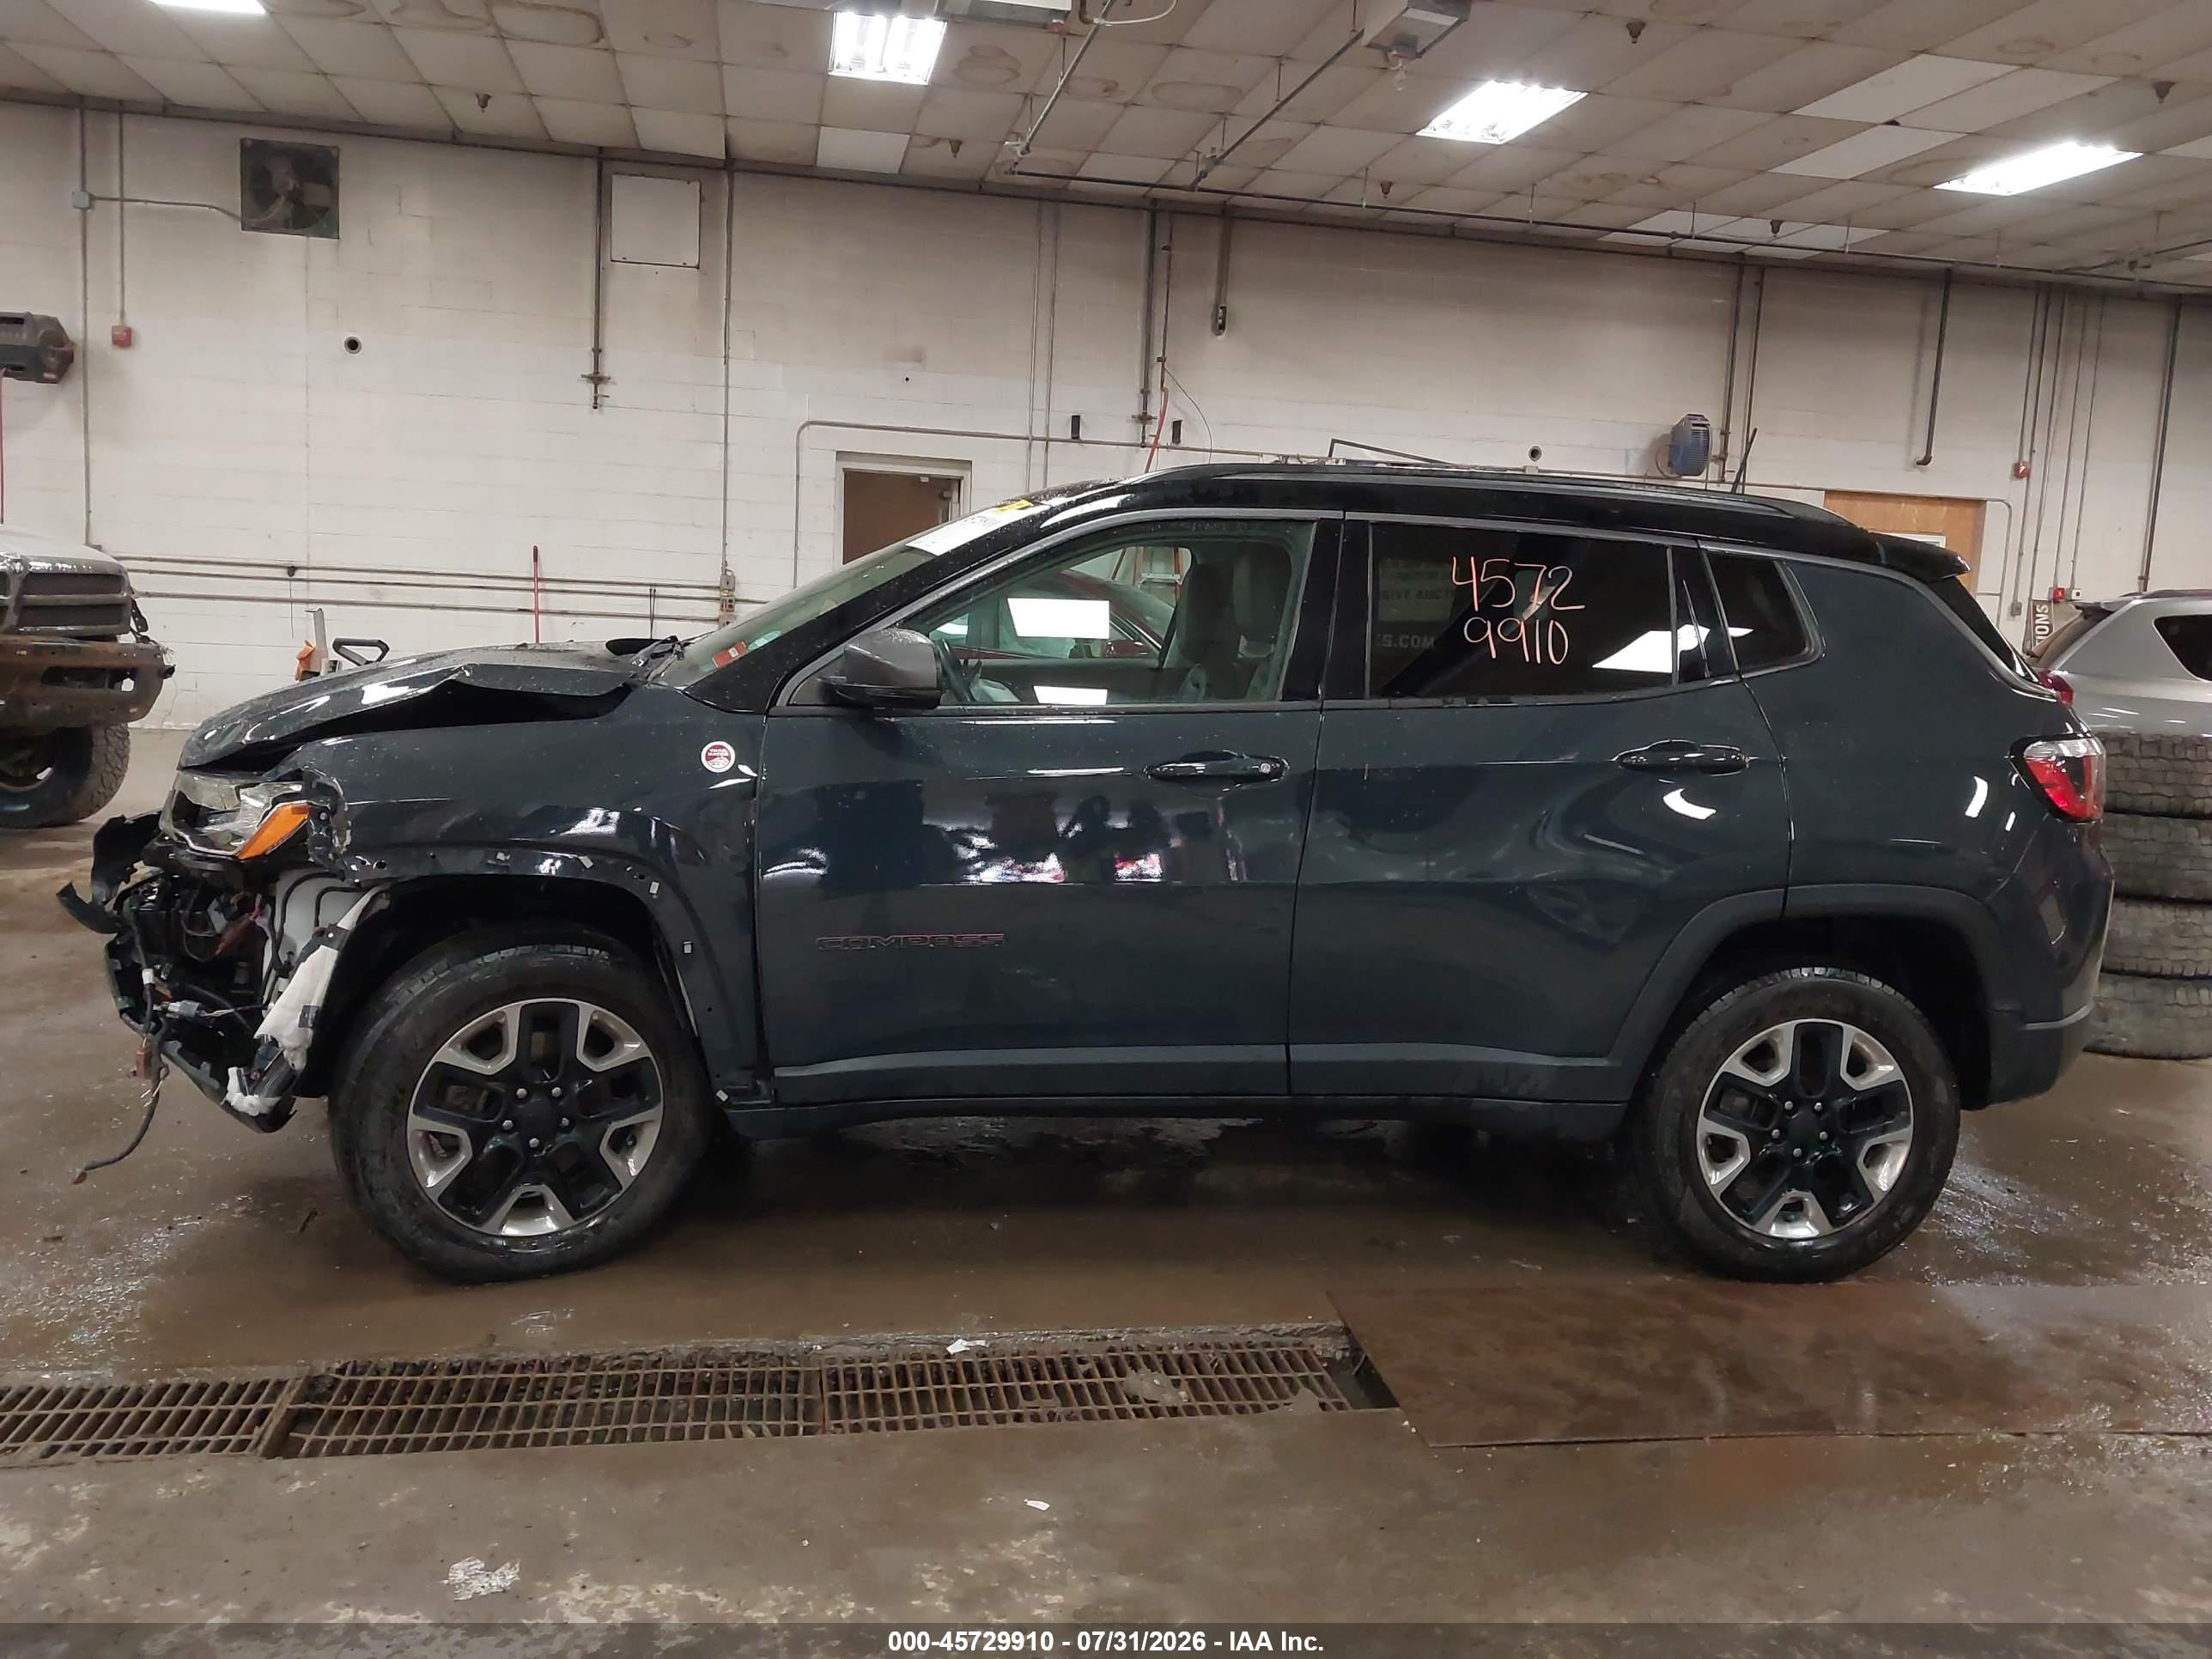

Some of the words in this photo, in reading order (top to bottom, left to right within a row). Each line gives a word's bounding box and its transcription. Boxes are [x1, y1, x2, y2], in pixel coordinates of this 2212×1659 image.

[1451, 556, 1586, 612] 4572
[1463, 617, 1569, 665] 9910
[816, 933, 1005, 950] COMPASS
